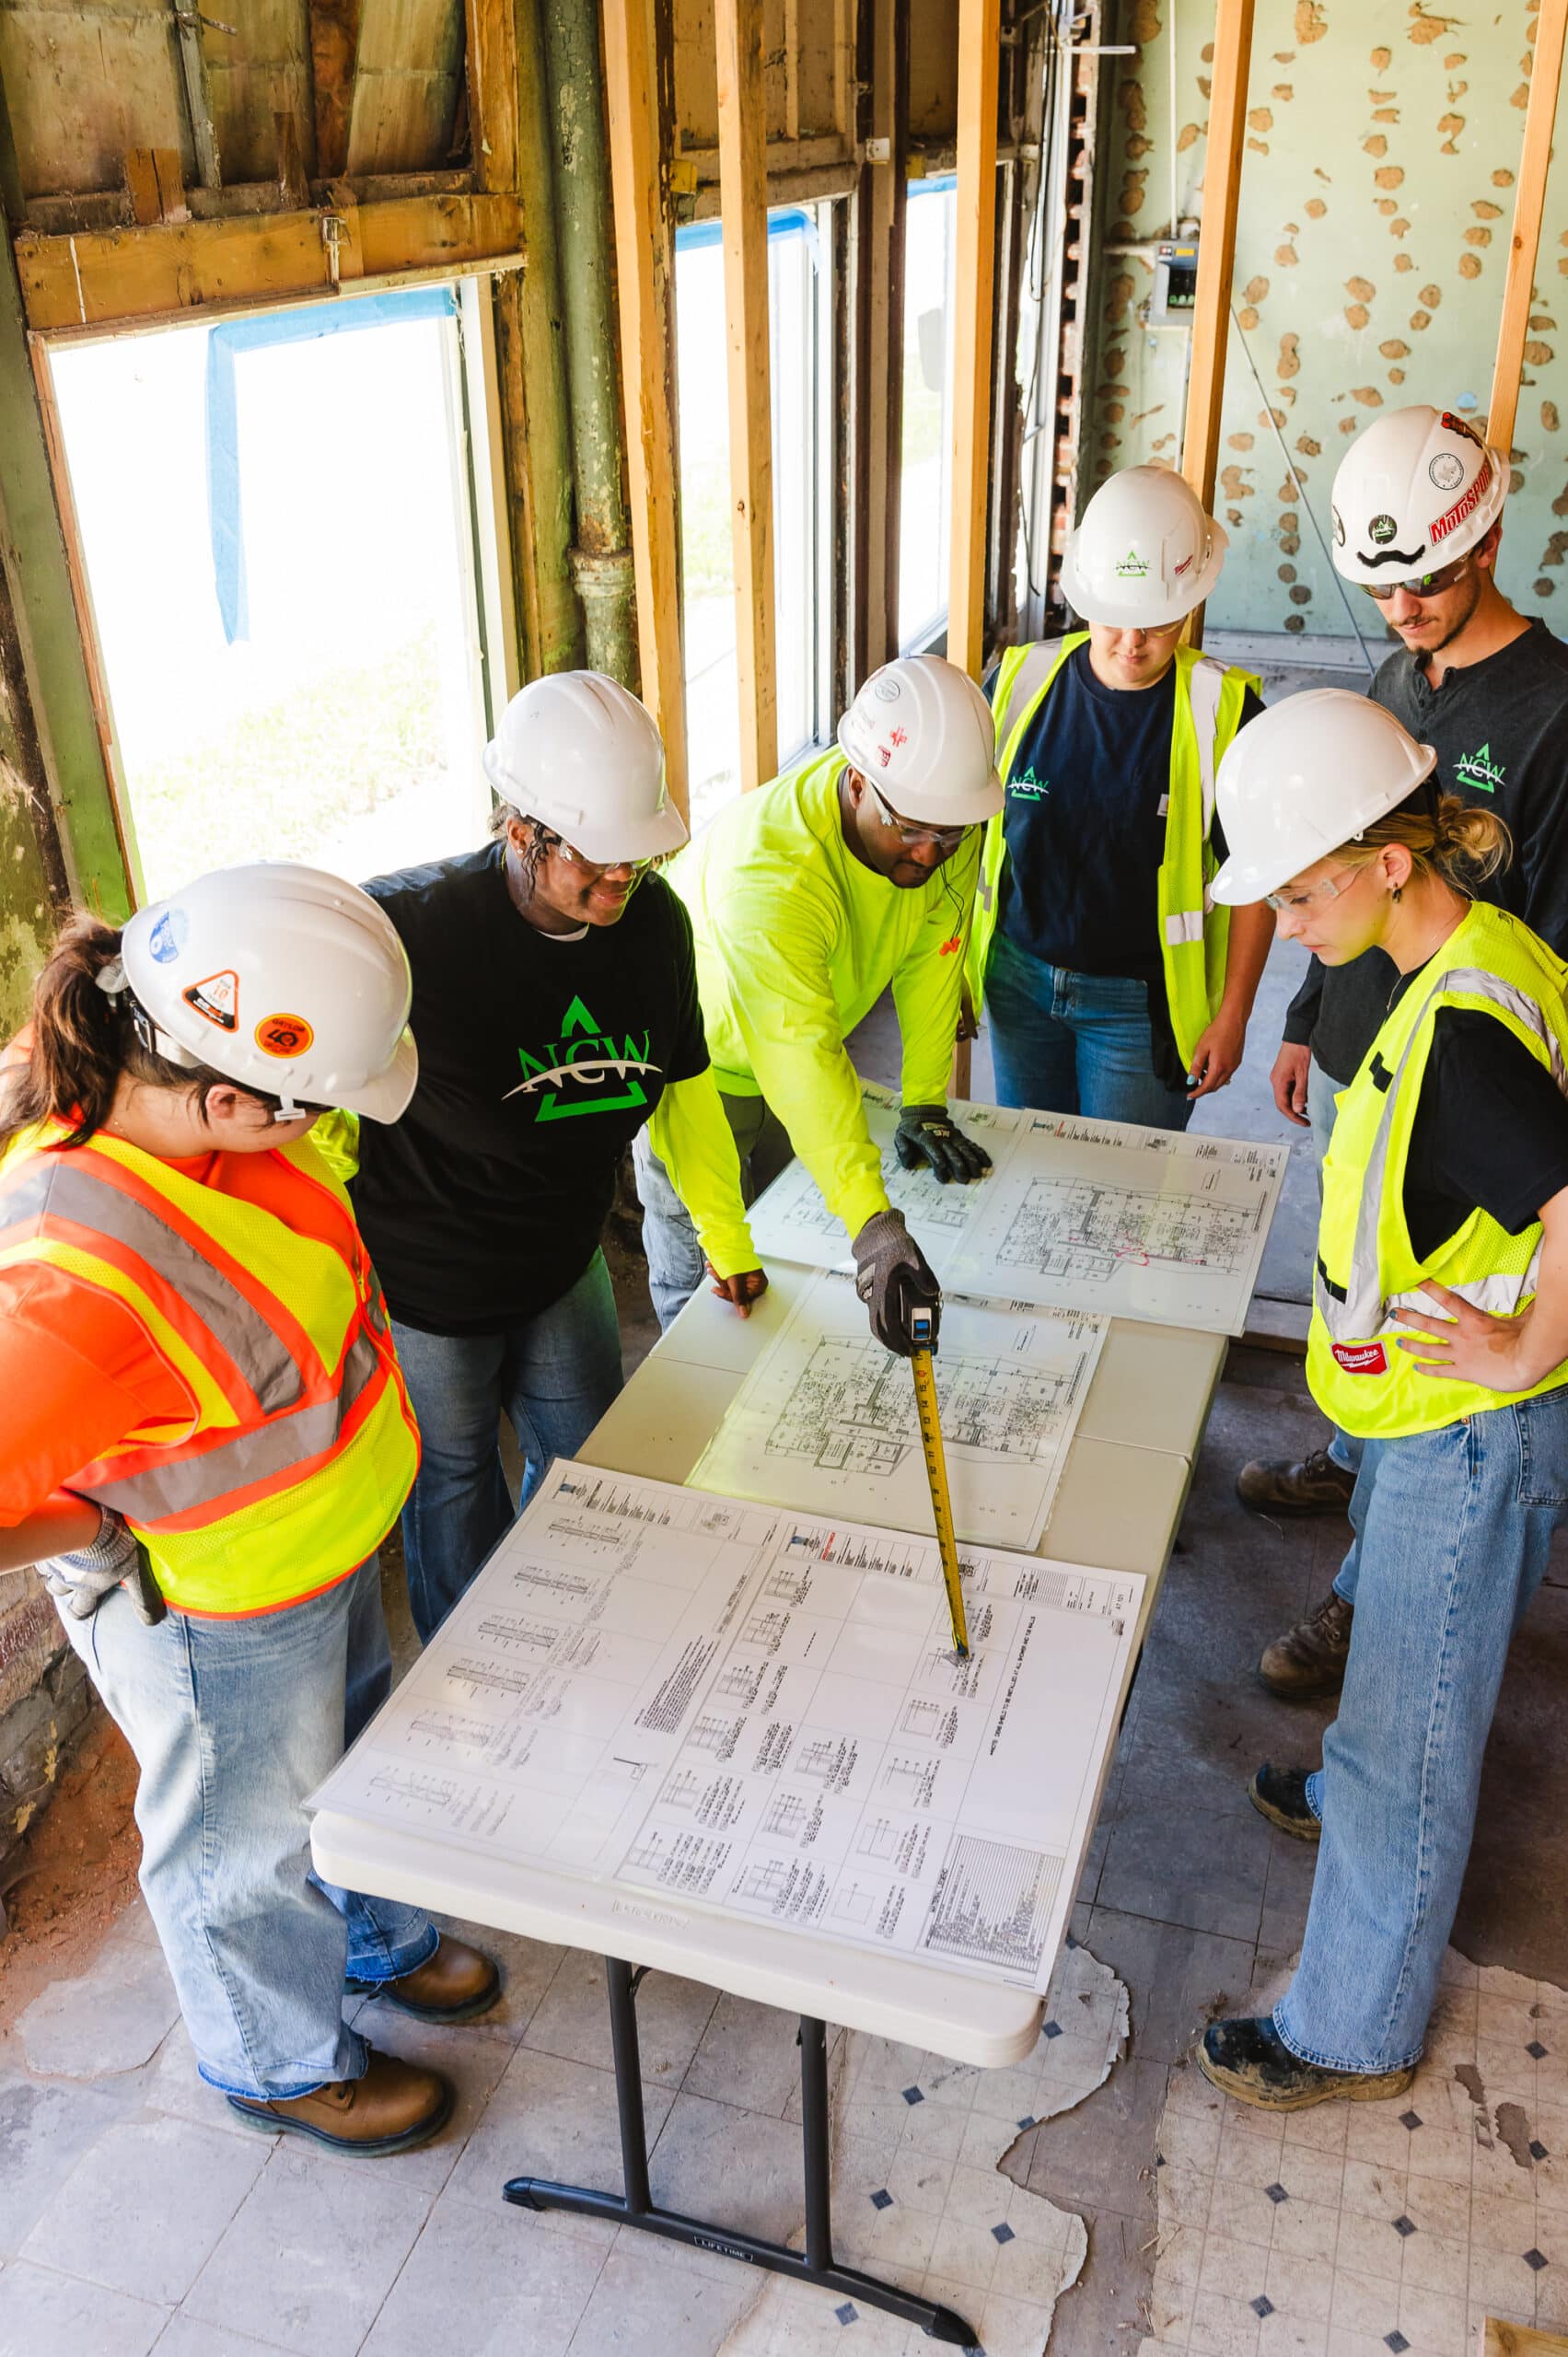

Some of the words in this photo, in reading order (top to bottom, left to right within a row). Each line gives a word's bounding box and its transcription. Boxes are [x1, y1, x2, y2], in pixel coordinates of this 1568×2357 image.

[1458, 752, 1506, 783] NCW
[1011, 776, 1050, 793] NCW
[516, 1029, 650, 1093] NCW
[1335, 1349, 1379, 1364] Milwaukee
